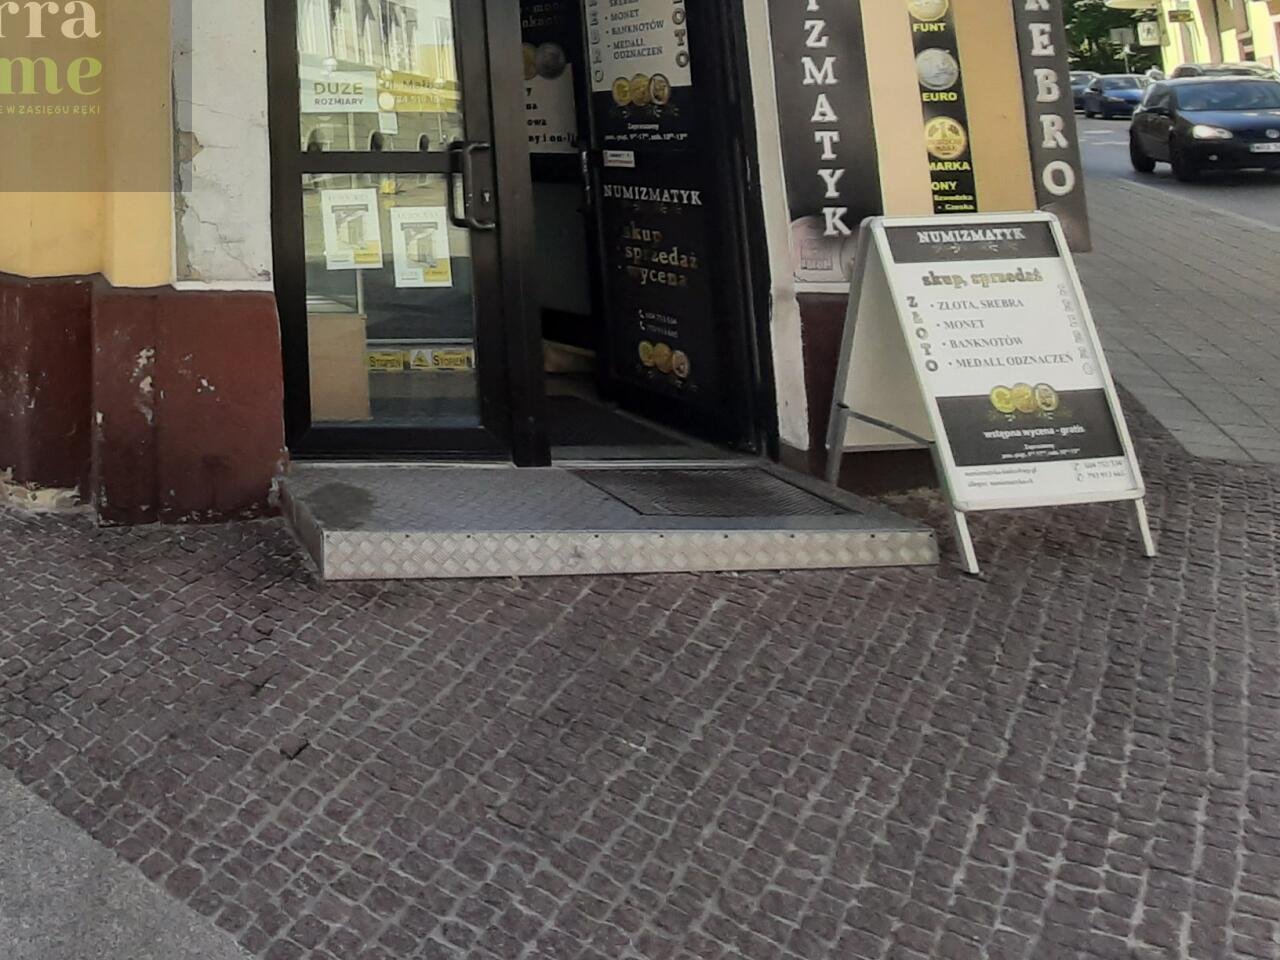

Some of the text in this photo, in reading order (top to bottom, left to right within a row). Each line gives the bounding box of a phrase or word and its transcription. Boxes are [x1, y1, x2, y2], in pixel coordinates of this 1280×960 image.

[610, 8, 640, 22] MONET
[611, 20, 664, 36] BANKNOTÓW
[912, 22, 946, 32] FUNT
[314, 98, 364, 106] ROZMIARY
[922, 92, 958, 102] EURO
[931, 181, 958, 191] ONY
[603, 184, 703, 206] NUMIZMATYK
[916, 228, 1026, 244] NUMIZMATYK
[981, 298, 1025, 310] SREBRA
[943, 319, 985, 330] MONET
[949, 334, 1025, 350] BANKNOTÓW
